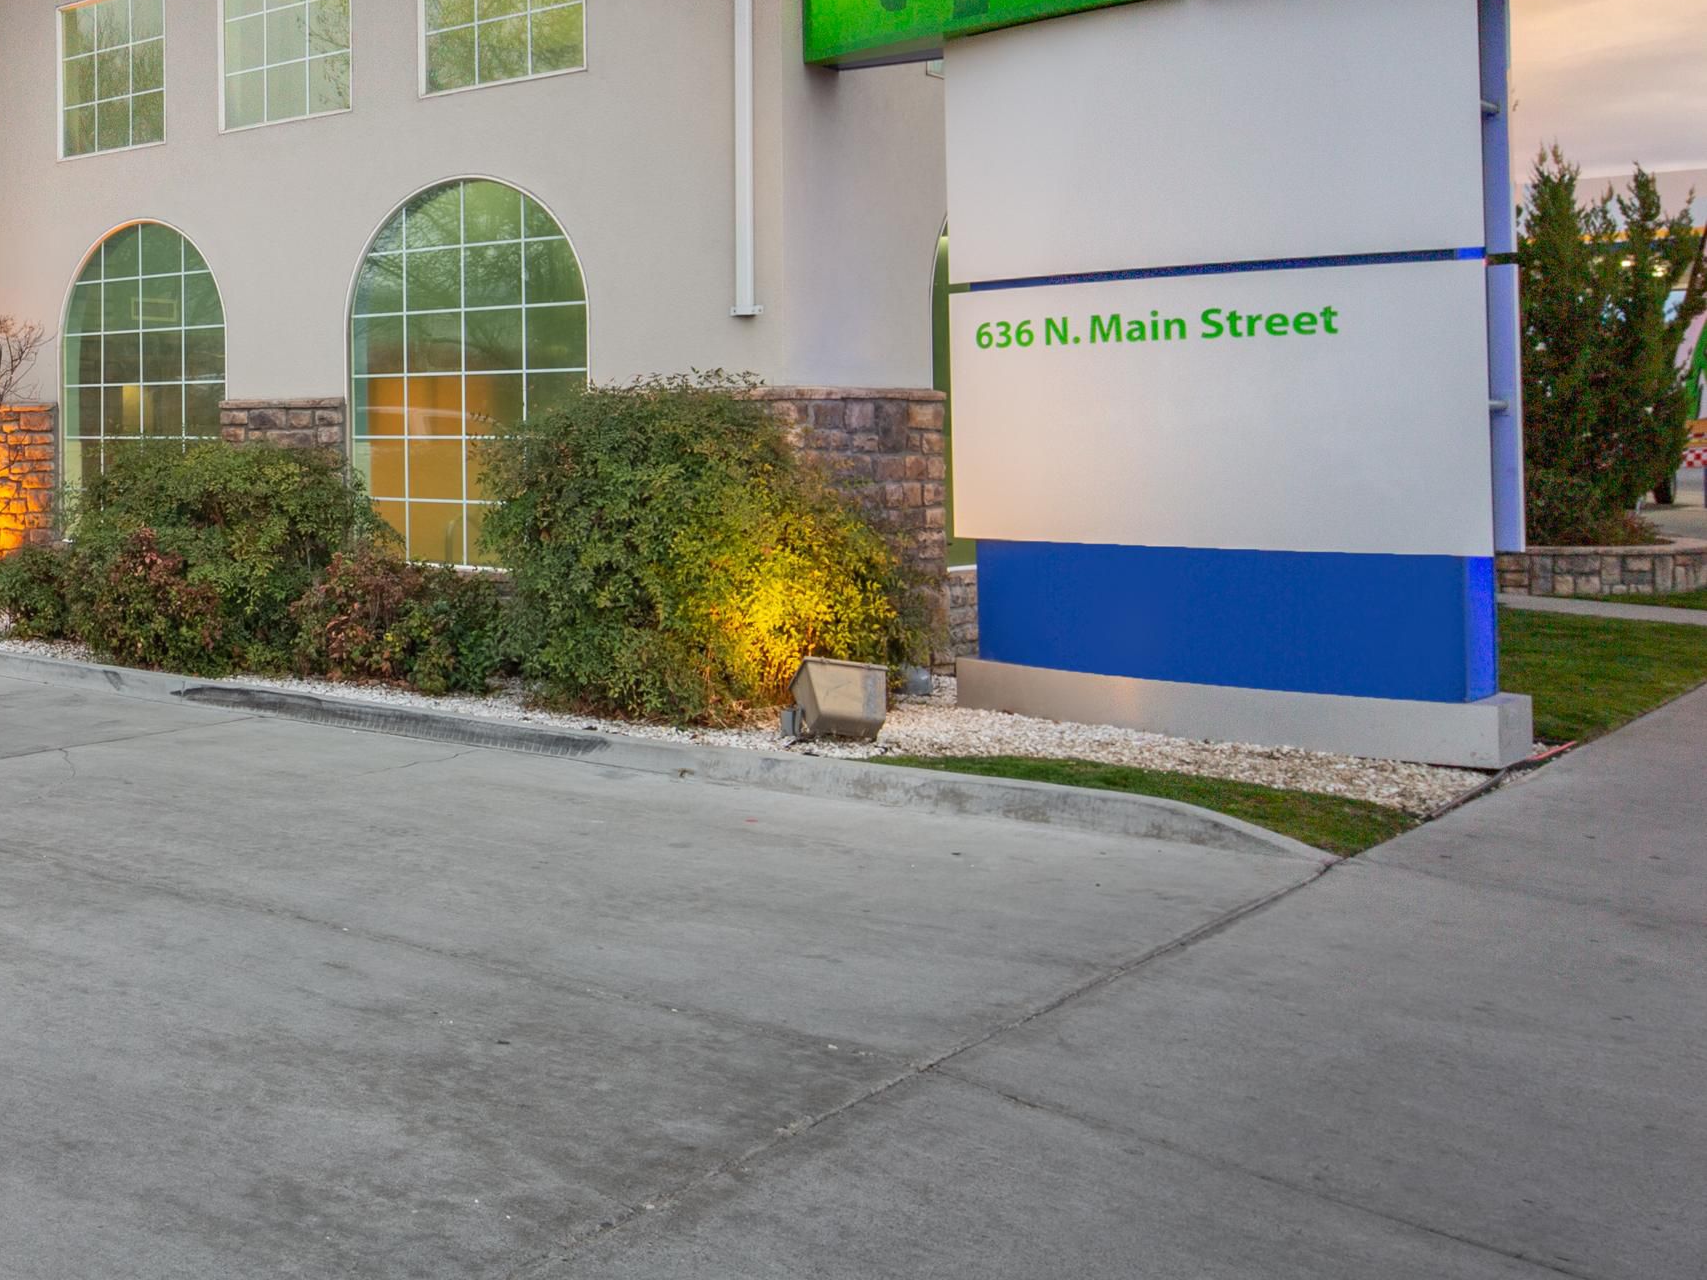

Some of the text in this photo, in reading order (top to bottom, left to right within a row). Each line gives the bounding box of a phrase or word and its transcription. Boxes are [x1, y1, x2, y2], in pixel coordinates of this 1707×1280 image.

[976, 305, 1339, 349] 636 N. Main Street
